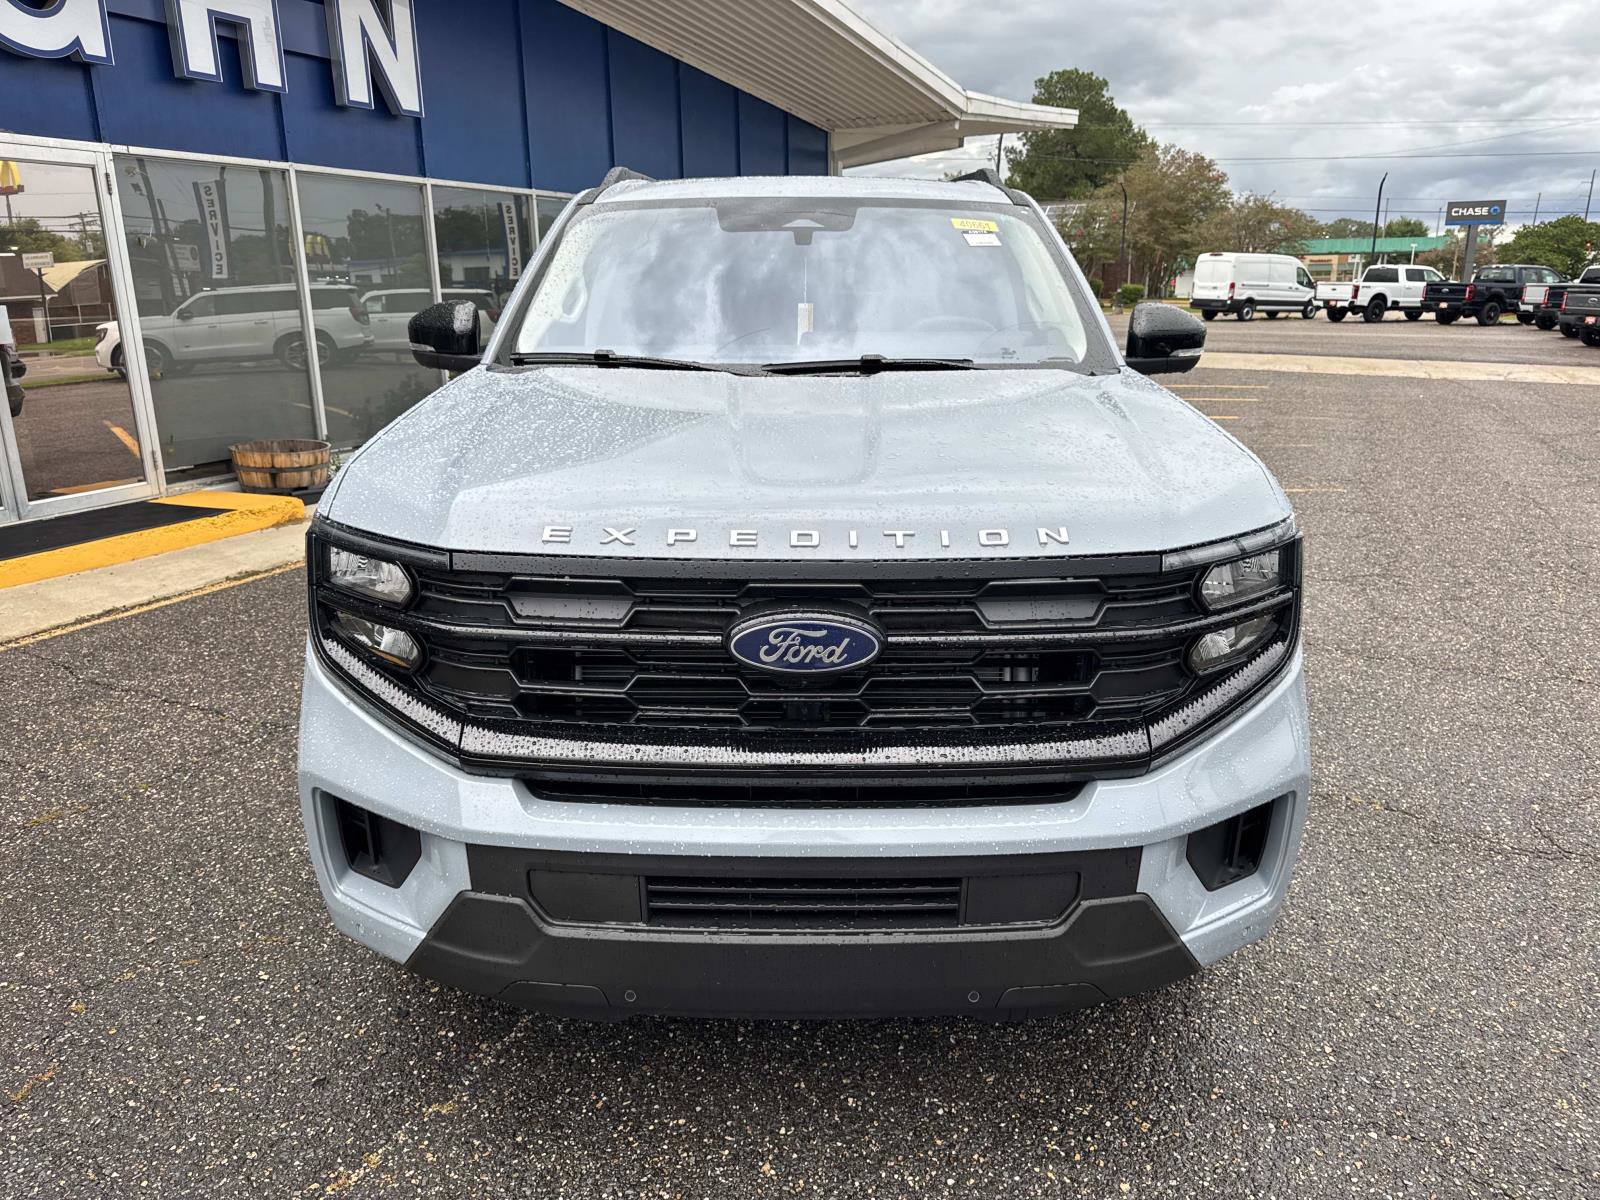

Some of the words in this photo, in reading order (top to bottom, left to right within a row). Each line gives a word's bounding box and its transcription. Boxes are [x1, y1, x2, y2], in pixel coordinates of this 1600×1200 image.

[1451, 206, 1489, 216] CHASE
[541, 525, 1070, 548] EXPEDITION
[759, 627, 851, 664] Ford
